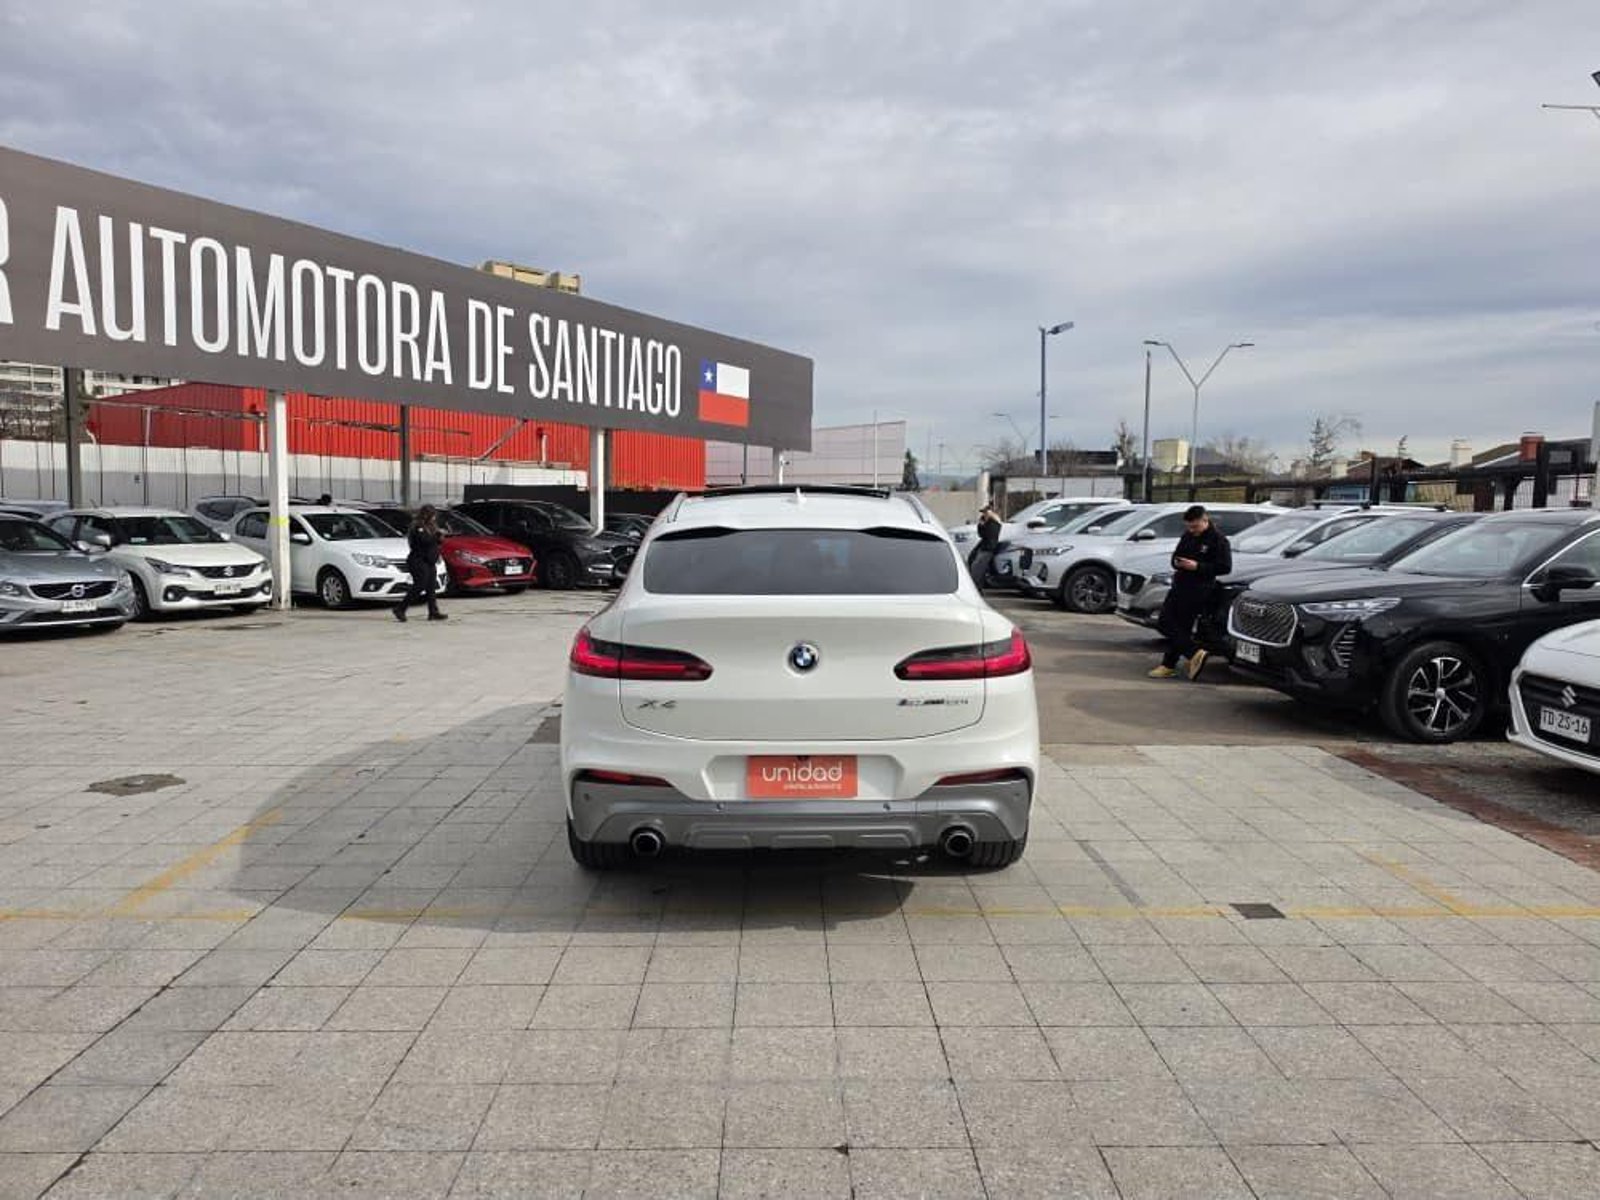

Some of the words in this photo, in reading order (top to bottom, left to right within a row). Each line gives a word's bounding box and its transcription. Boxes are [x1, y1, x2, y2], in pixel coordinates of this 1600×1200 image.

[46, 205, 453, 385] AUTOMOTORA
[468, 298, 514, 395] DE
[528, 312, 682, 419] SANTIAGO
[762, 760, 843, 782] unidad
